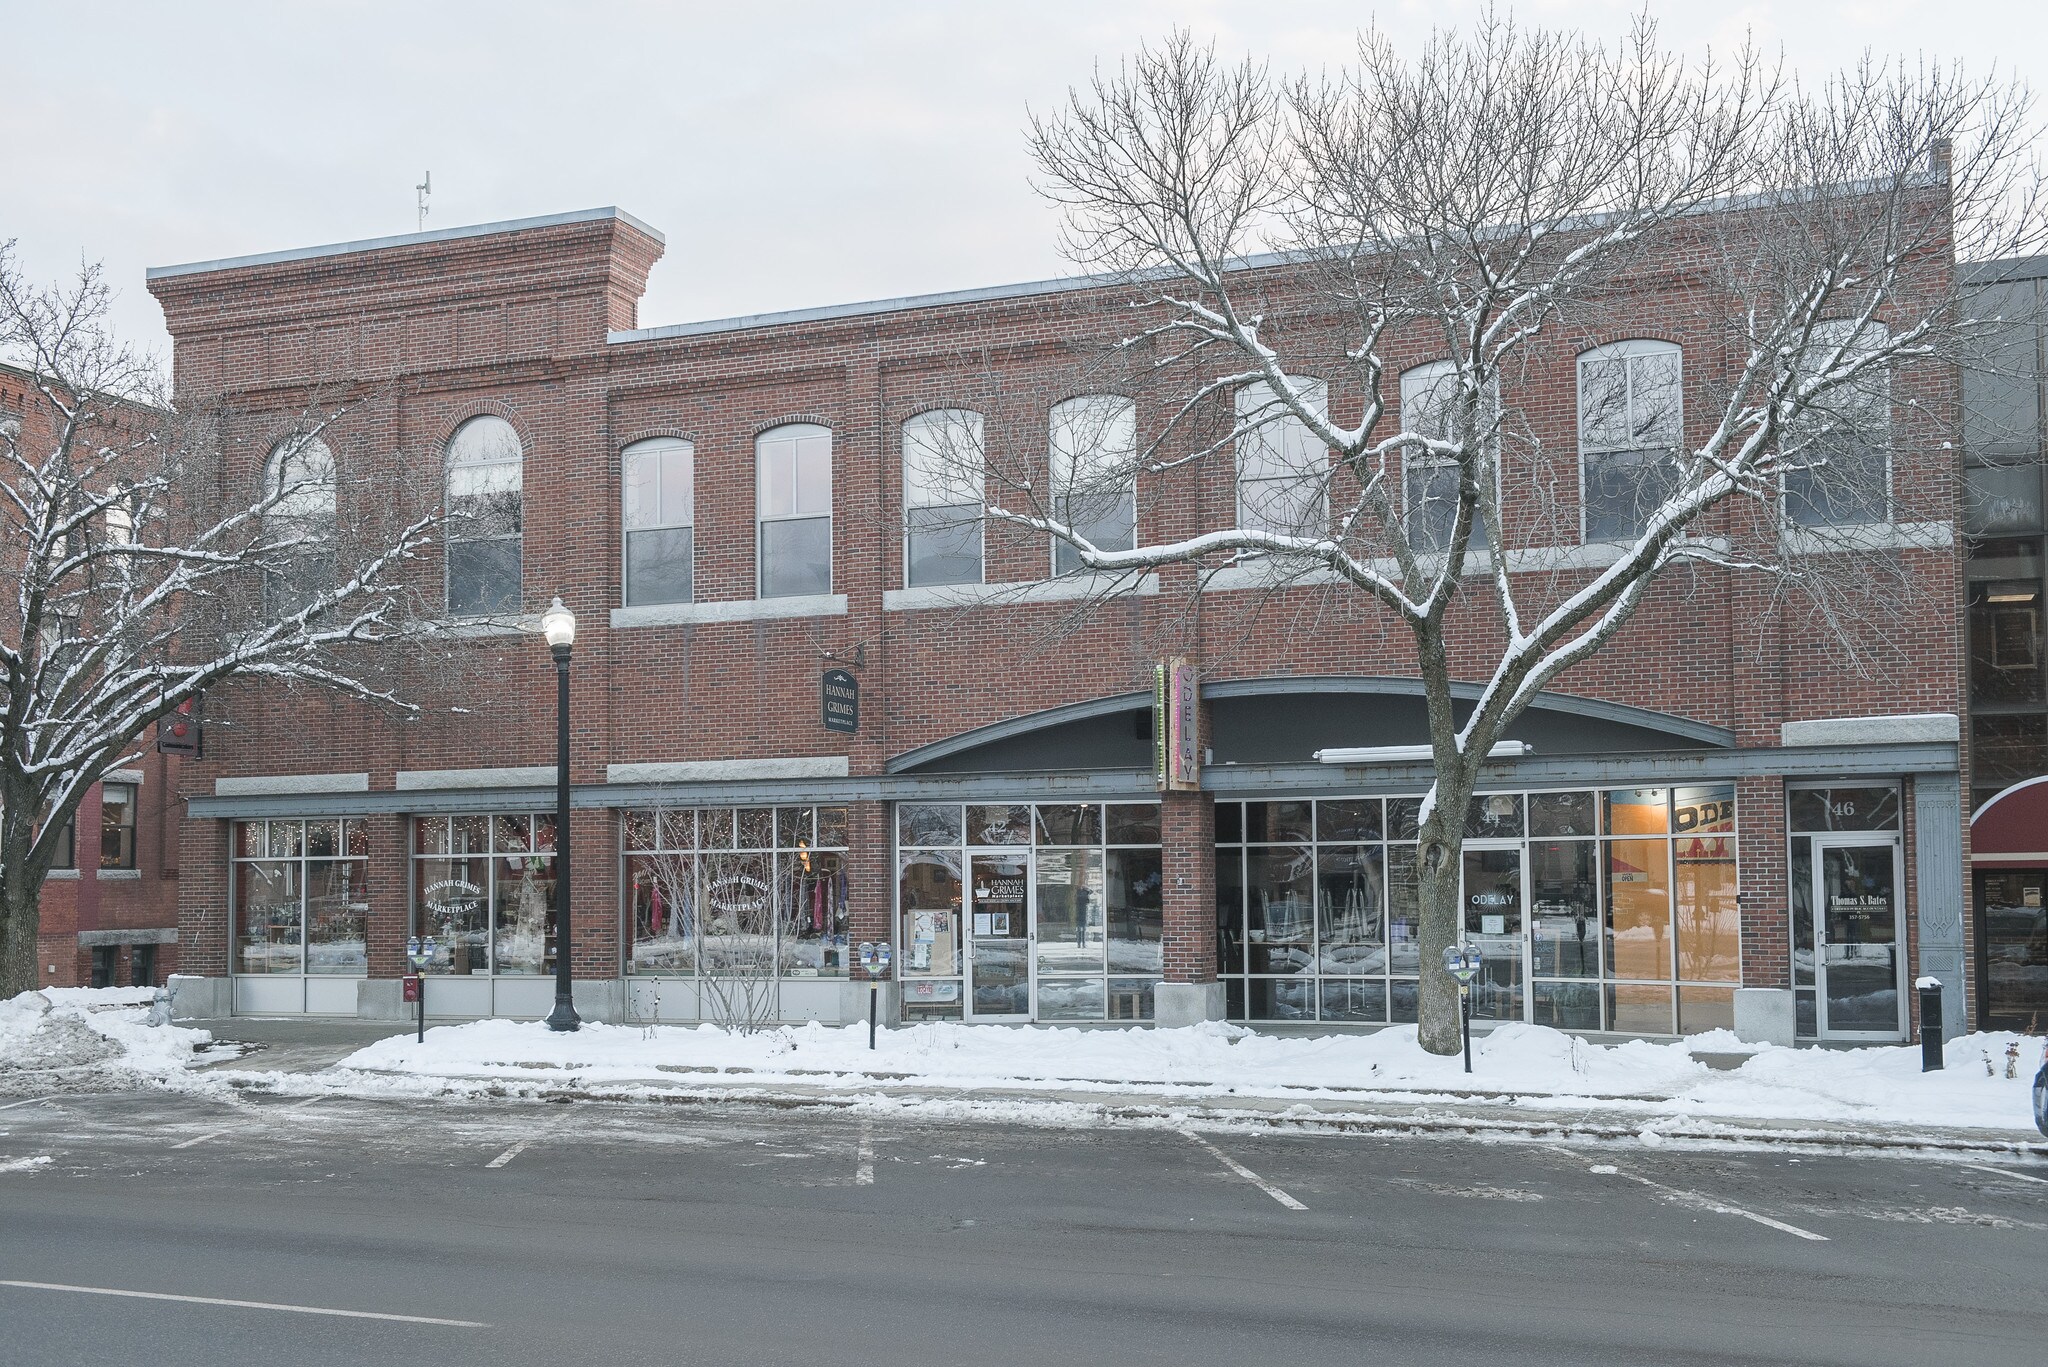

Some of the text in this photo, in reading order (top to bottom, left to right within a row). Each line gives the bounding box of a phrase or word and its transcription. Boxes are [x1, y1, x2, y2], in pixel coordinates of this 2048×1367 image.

[826, 684, 855, 700] HANNAH
[827, 701, 854, 715] GRIMES
[1832, 801, 1855, 816] 46
[424, 880, 481, 895] HANNAH GRIMES
[740, 876, 768, 891] GRIMES
[991, 886, 1024, 894] GRIMES
[426, 900, 479, 913] MARKETPLACE
[1472, 895, 1514, 904] ODELAY
[1831, 895, 1887, 905] Thomas S. Bates
